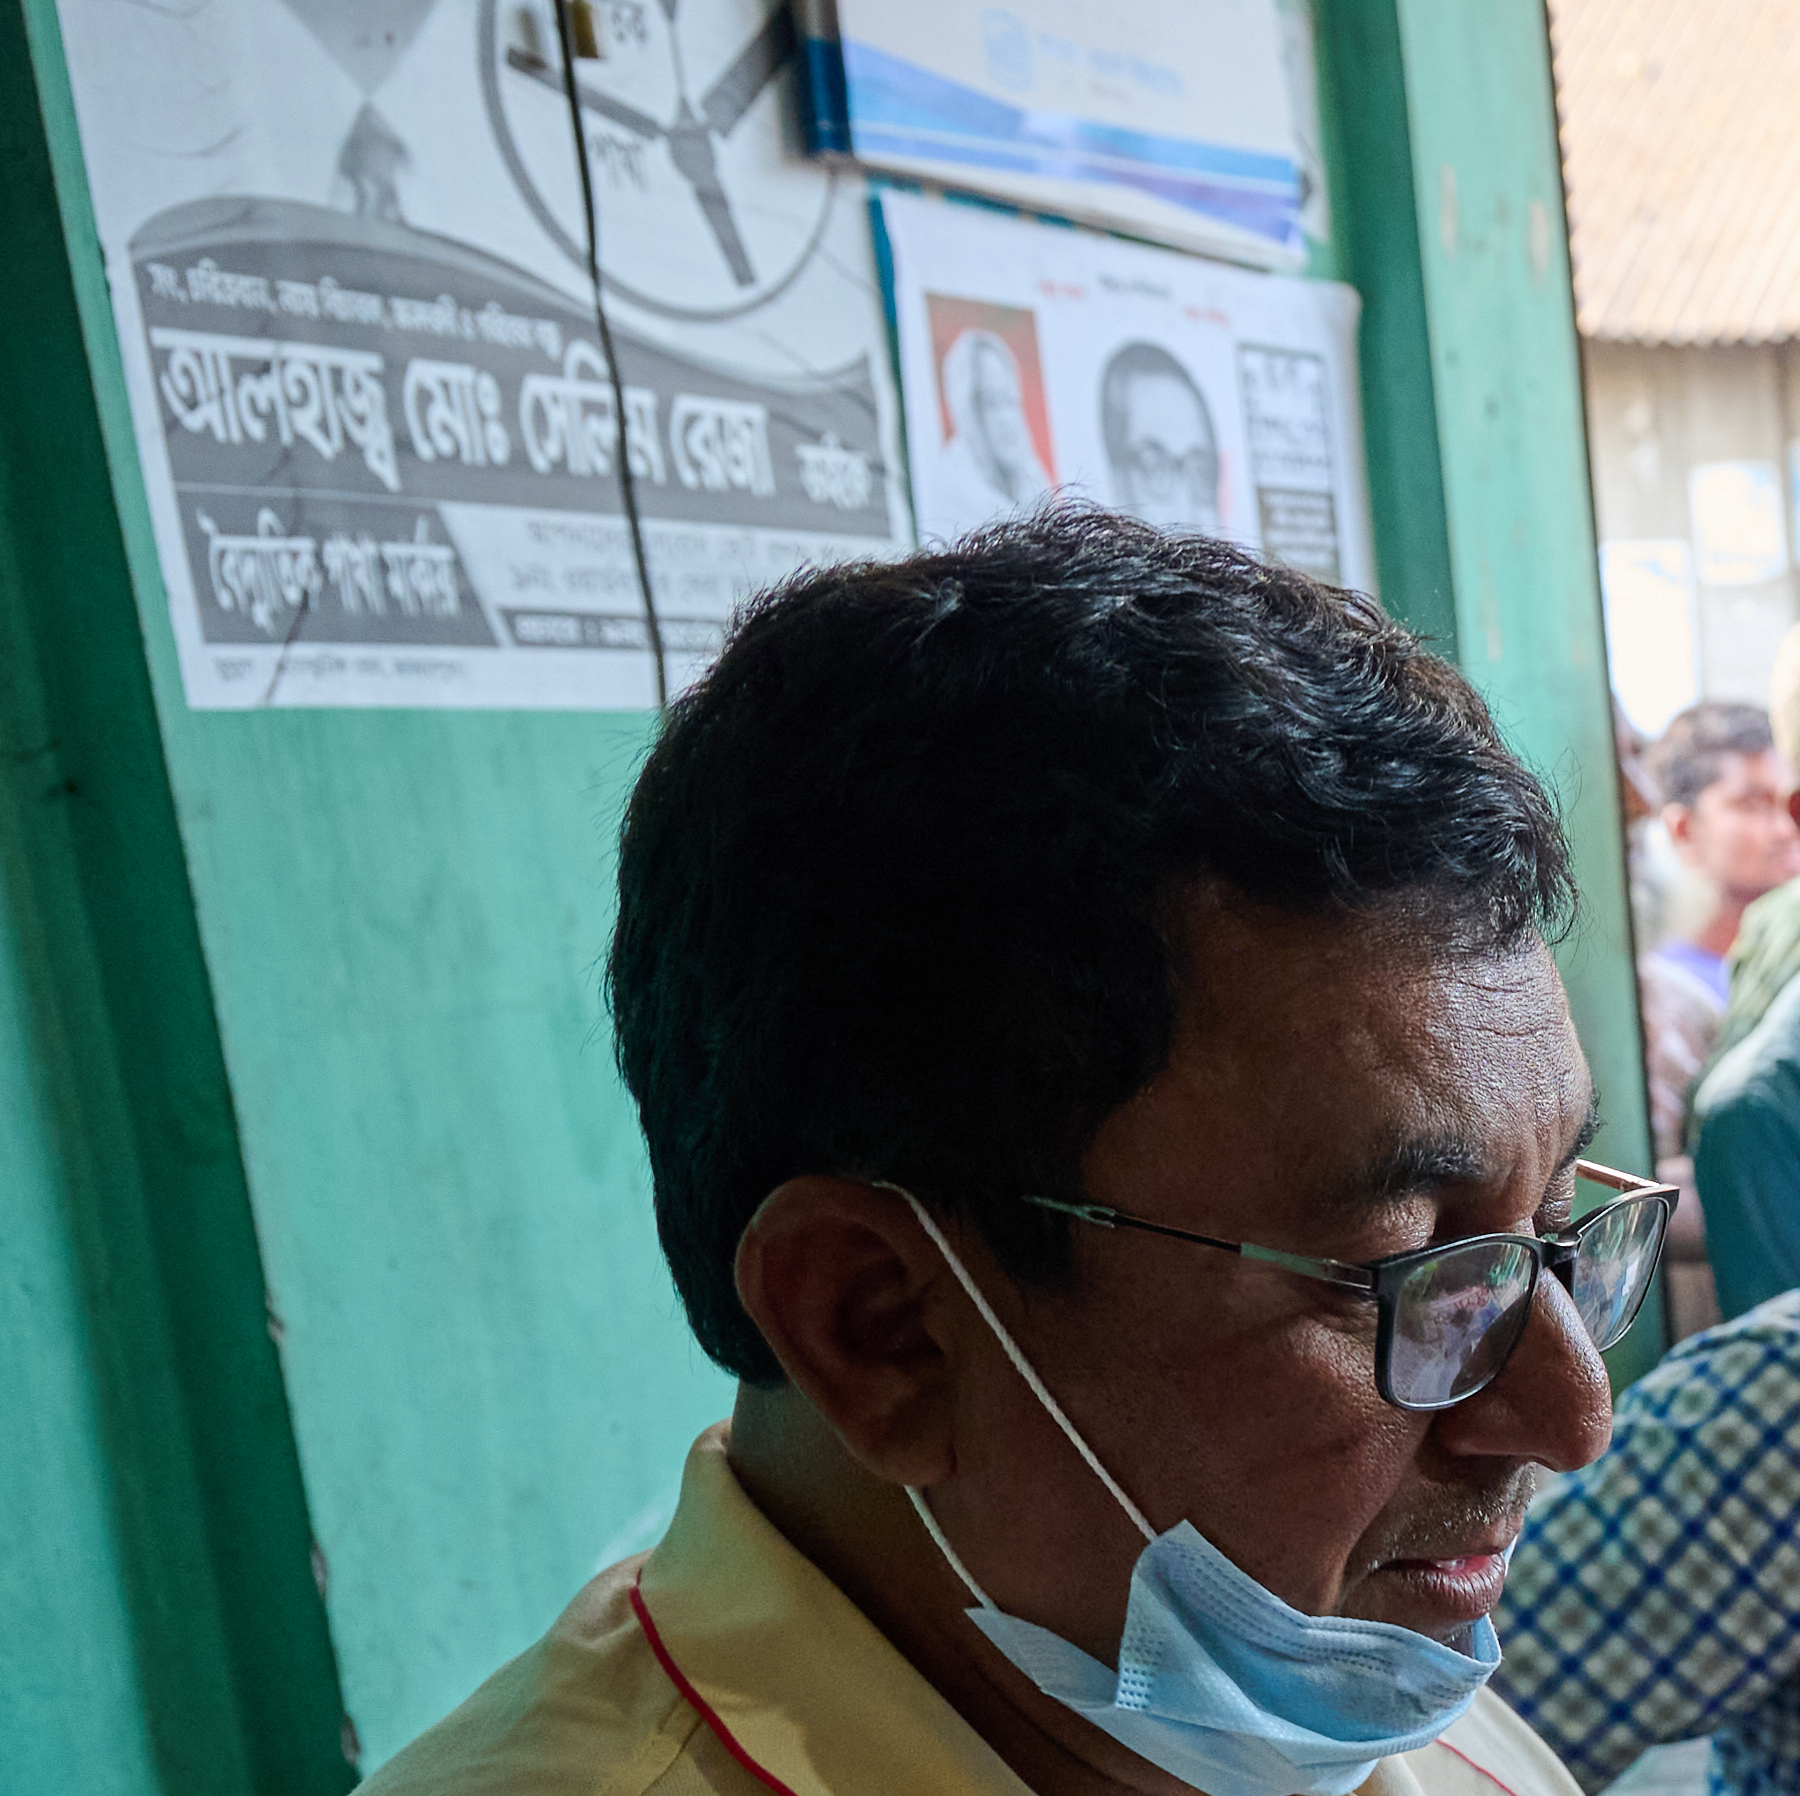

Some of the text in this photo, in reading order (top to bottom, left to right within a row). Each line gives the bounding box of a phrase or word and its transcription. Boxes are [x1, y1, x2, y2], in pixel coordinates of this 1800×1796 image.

[149, 328, 402, 493] আলহাজ্ব
[404, 358, 512, 467] মোঃ
[519, 339, 667, 486] সেলিম
[670, 393, 776, 499] রেজা
